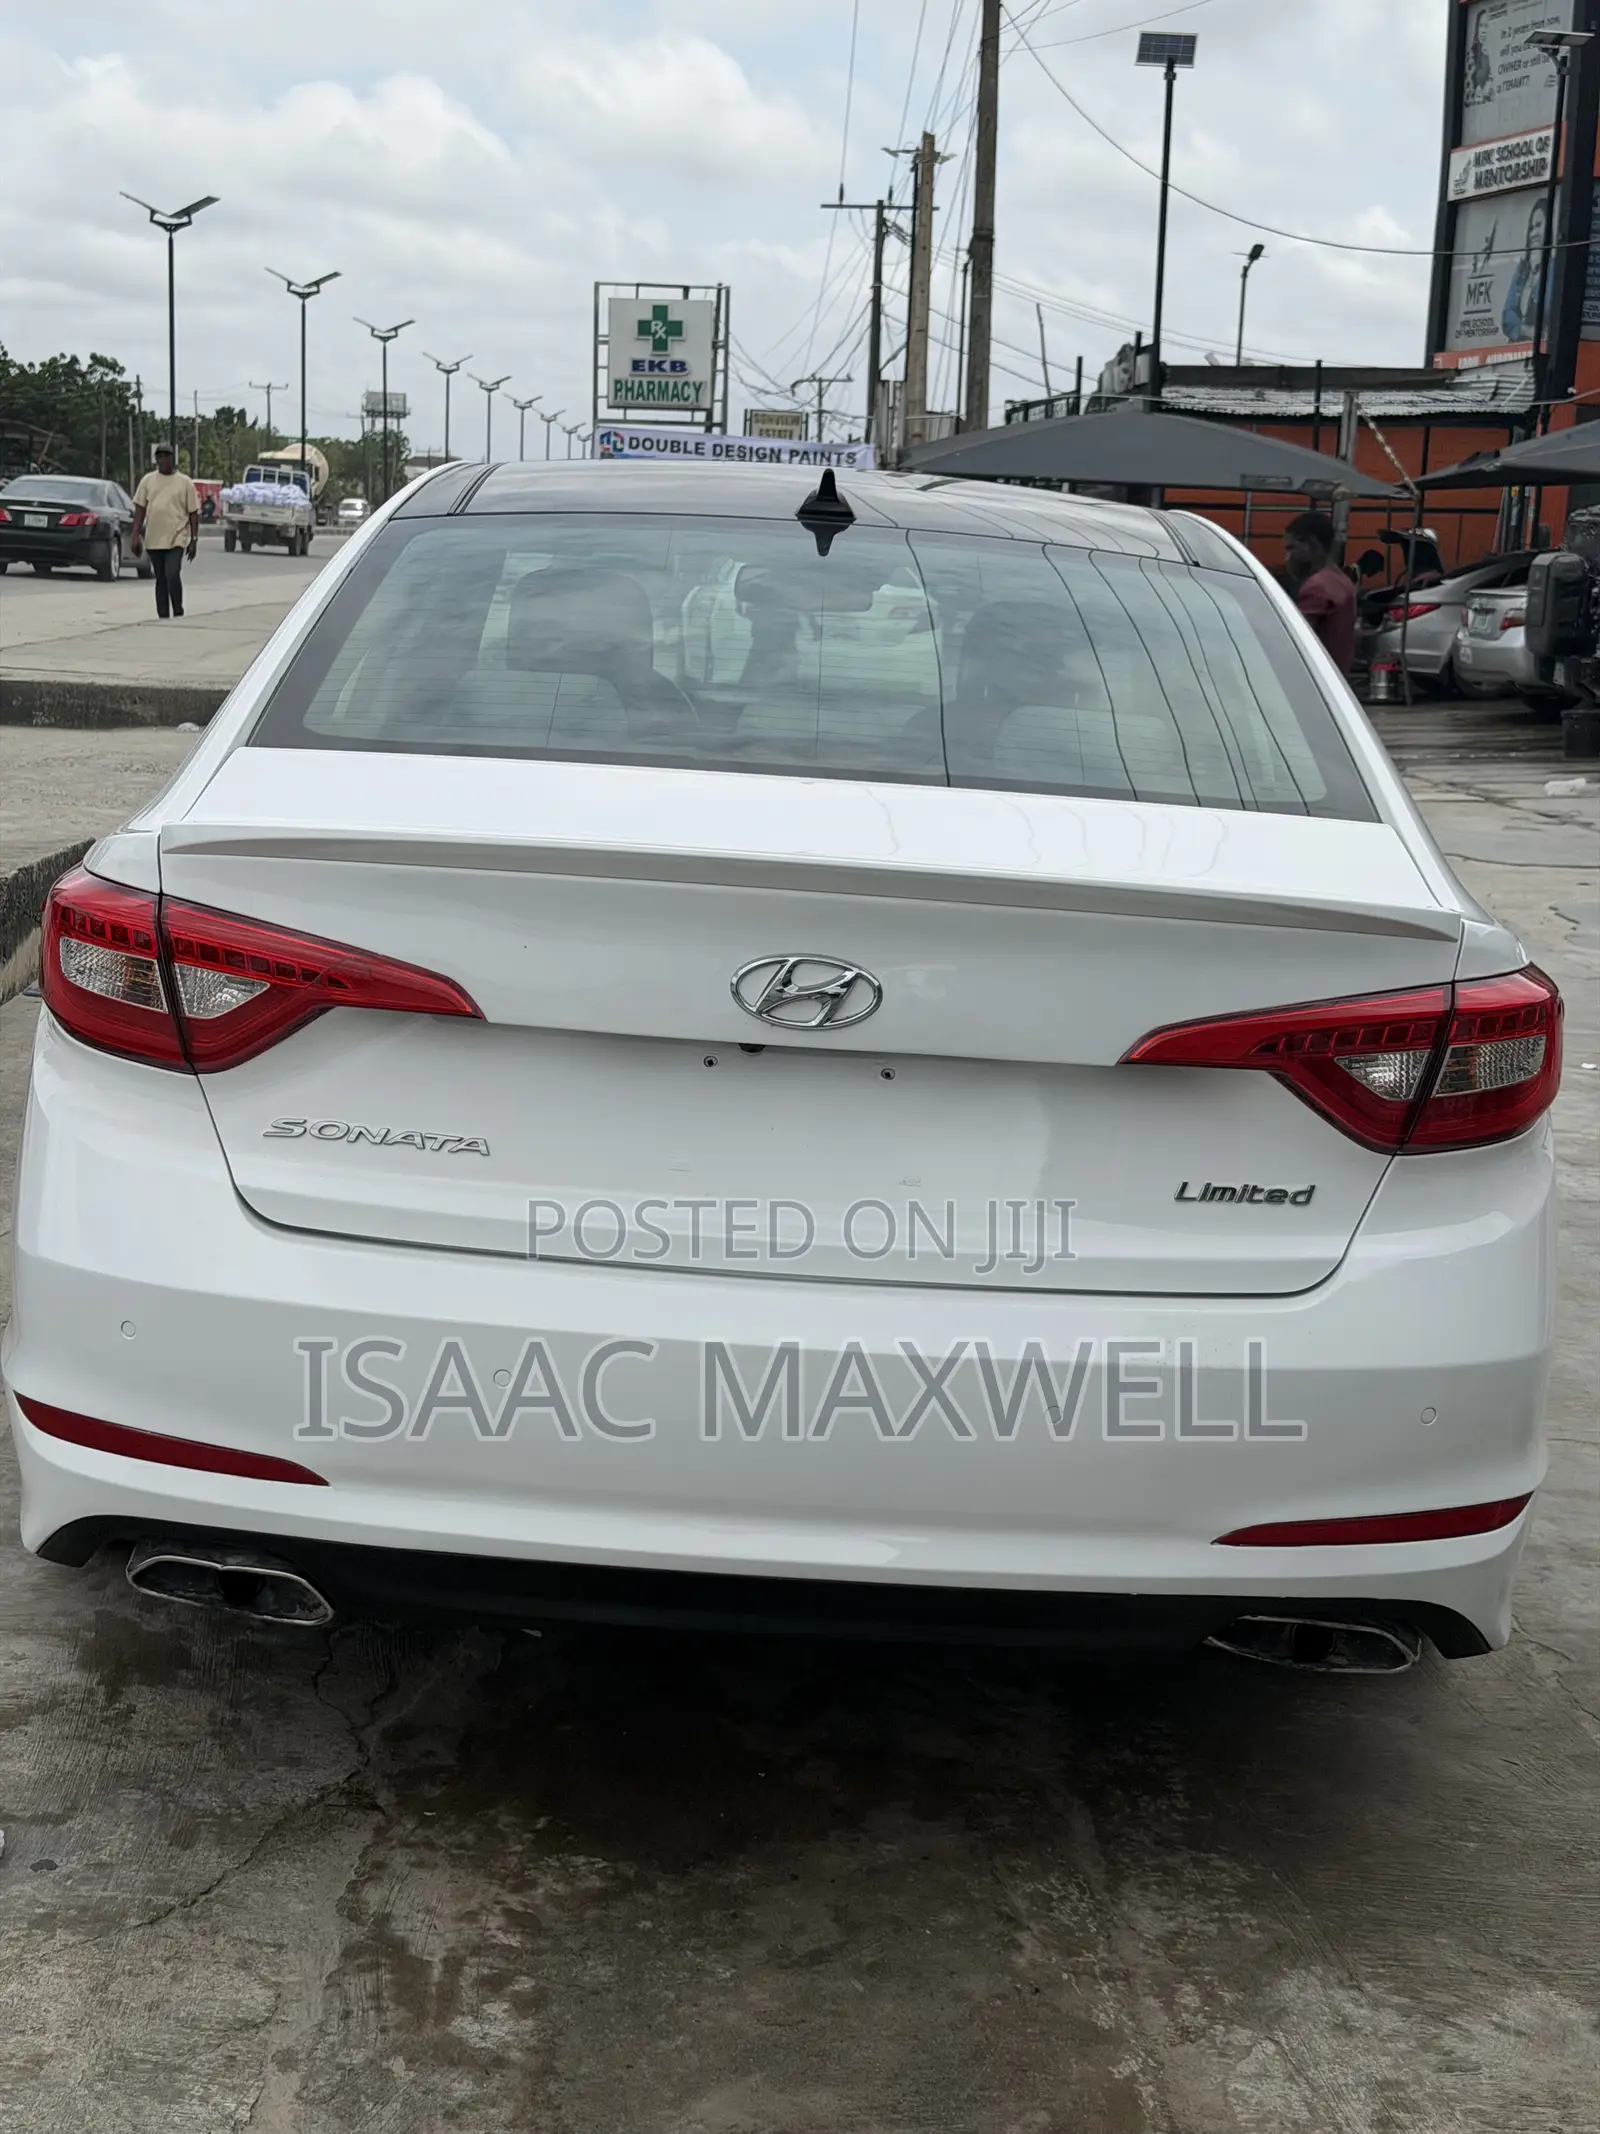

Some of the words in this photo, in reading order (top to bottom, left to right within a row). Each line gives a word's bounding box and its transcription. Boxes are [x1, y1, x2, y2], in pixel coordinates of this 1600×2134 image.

[1496, 139, 1535, 163] SCHOOL
[1535, 135, 1551, 153] OF
[1474, 157, 1549, 190] MENTORSHIP
[1465, 280, 1494, 305] MFK
[632, 359, 688, 374] EKB
[614, 379, 703, 404] PHARMACY
[628, 436, 705, 456] DOUBLE
[712, 443, 782, 462] DESIGN
[789, 449, 857, 467] PAINTS
[262, 1117, 490, 1156] SONATA
[1174, 1181, 1316, 1206] Limited
